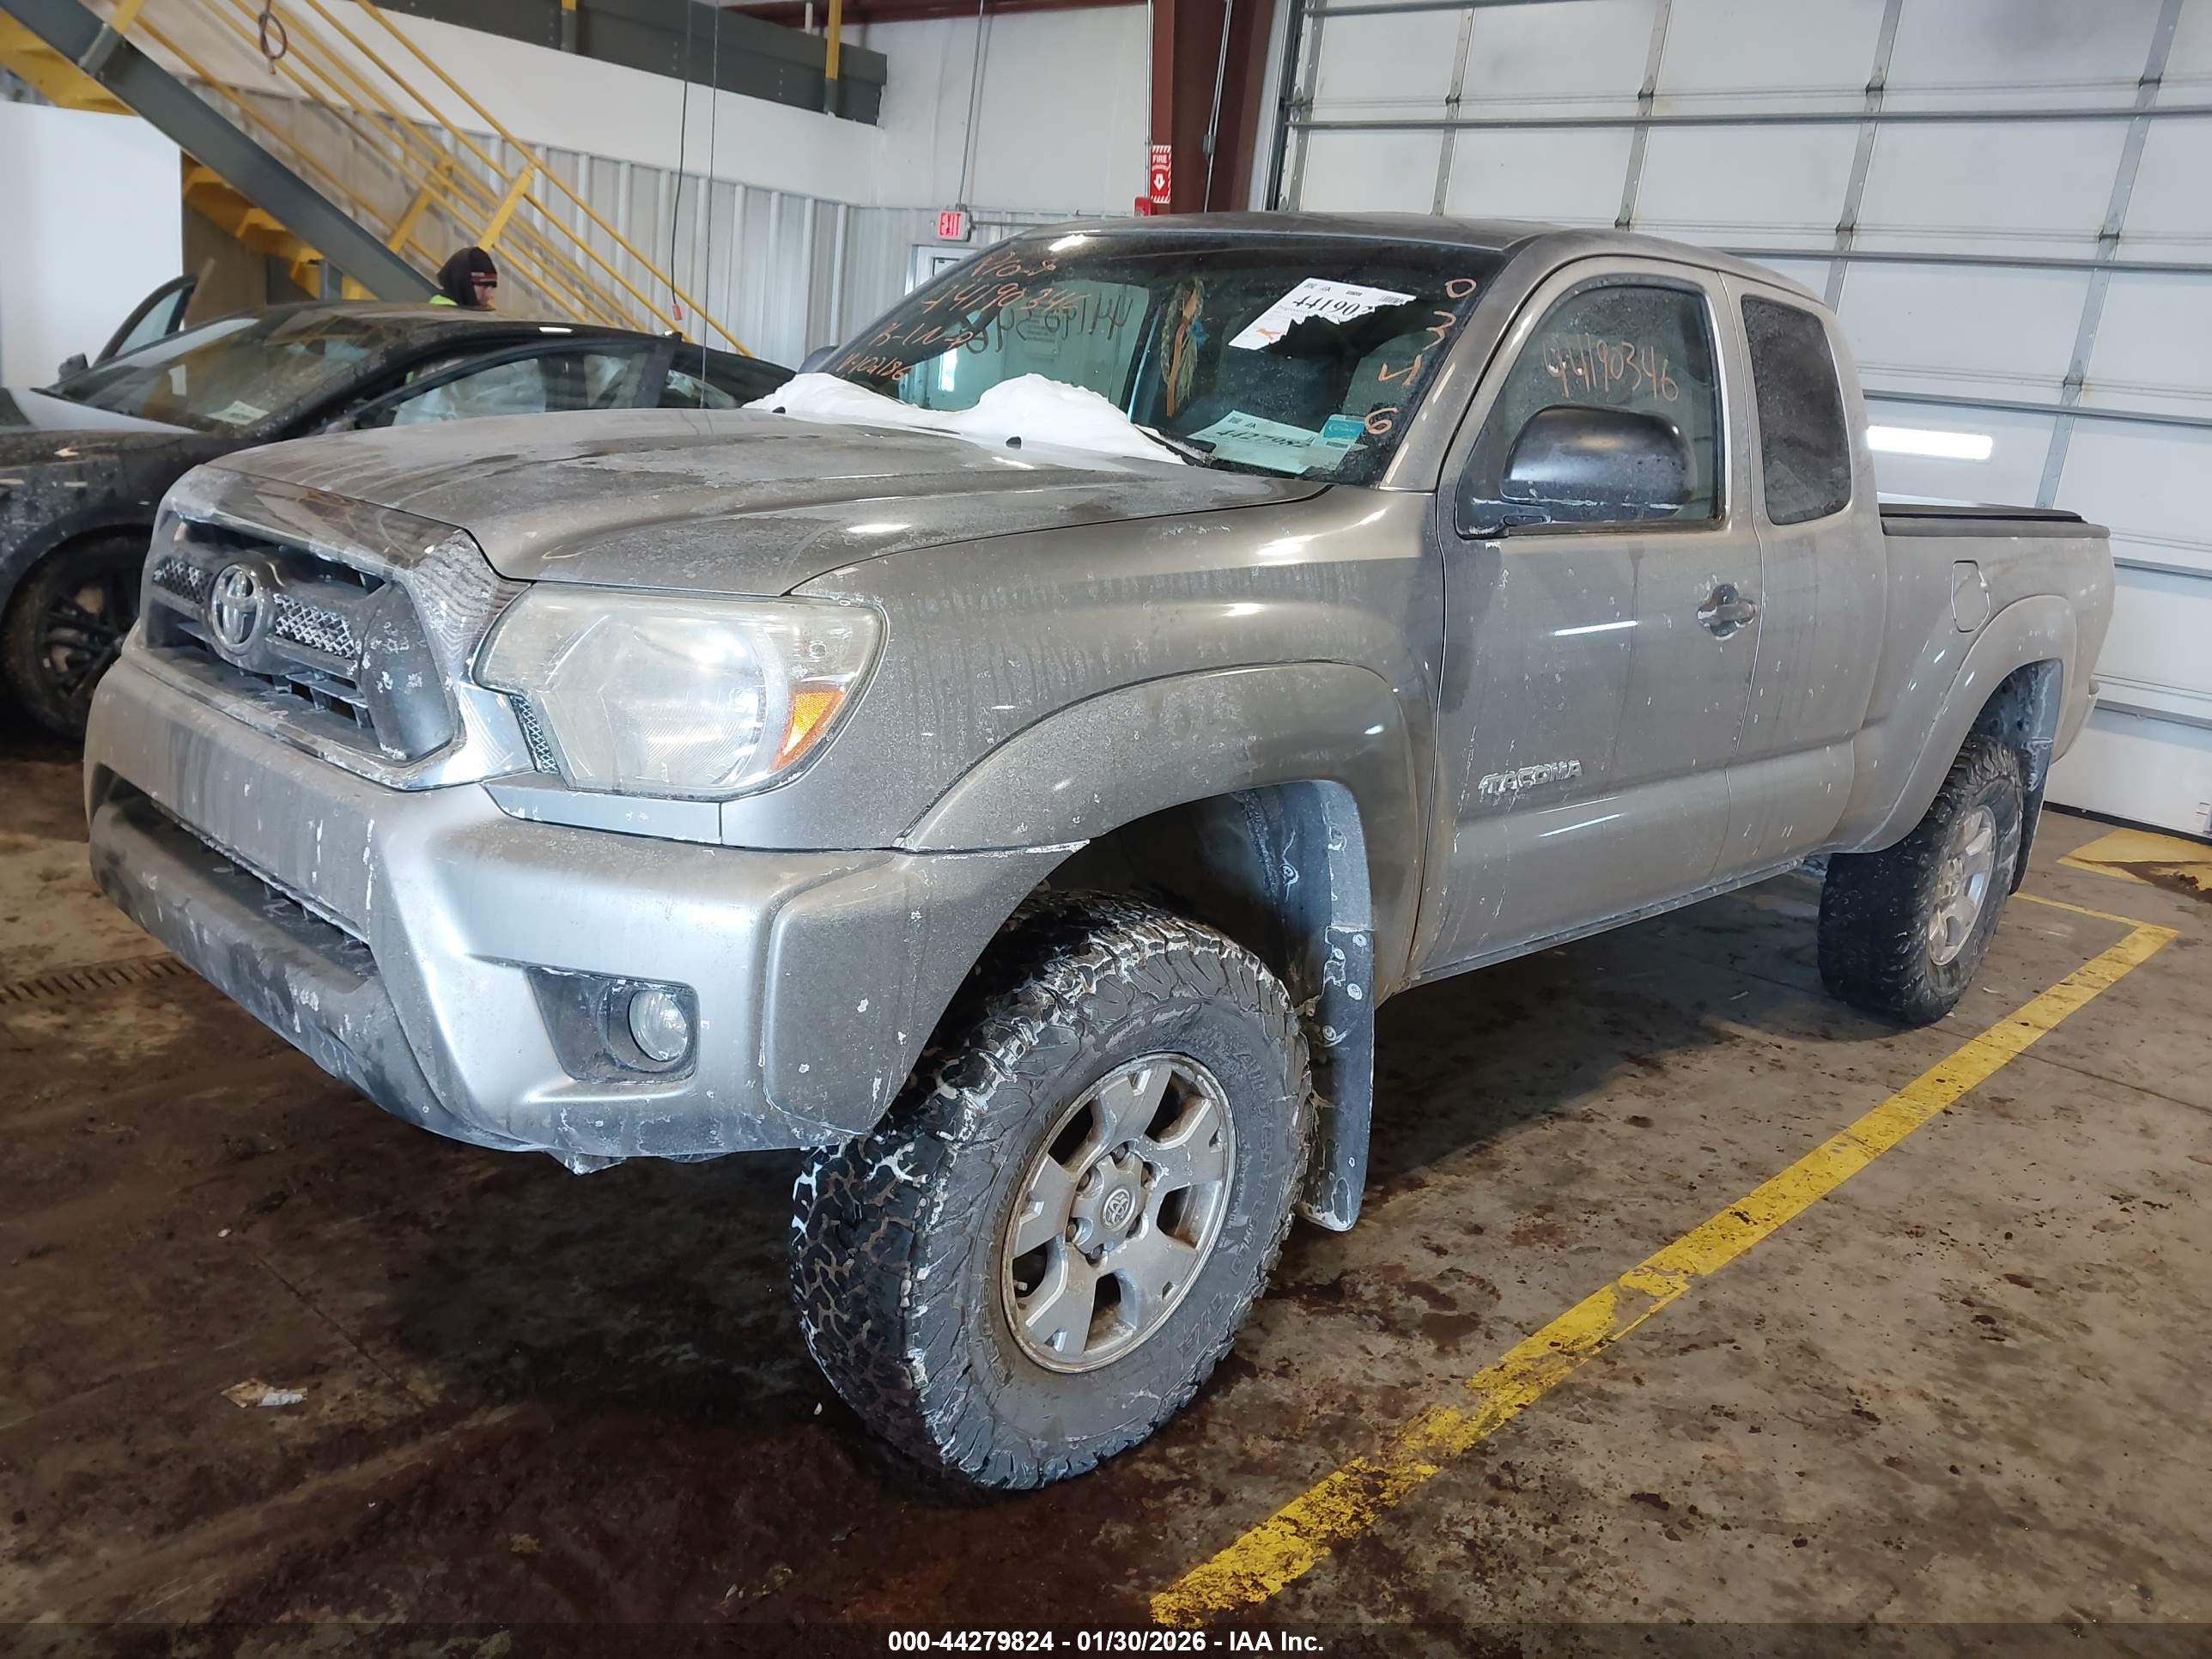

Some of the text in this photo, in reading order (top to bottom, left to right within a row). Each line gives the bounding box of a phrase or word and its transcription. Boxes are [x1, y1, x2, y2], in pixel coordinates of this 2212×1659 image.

[1152, 154, 1168, 164] FIRE
[939, 211, 962, 236] EXIT
[1541, 333, 1679, 401] 44190346
